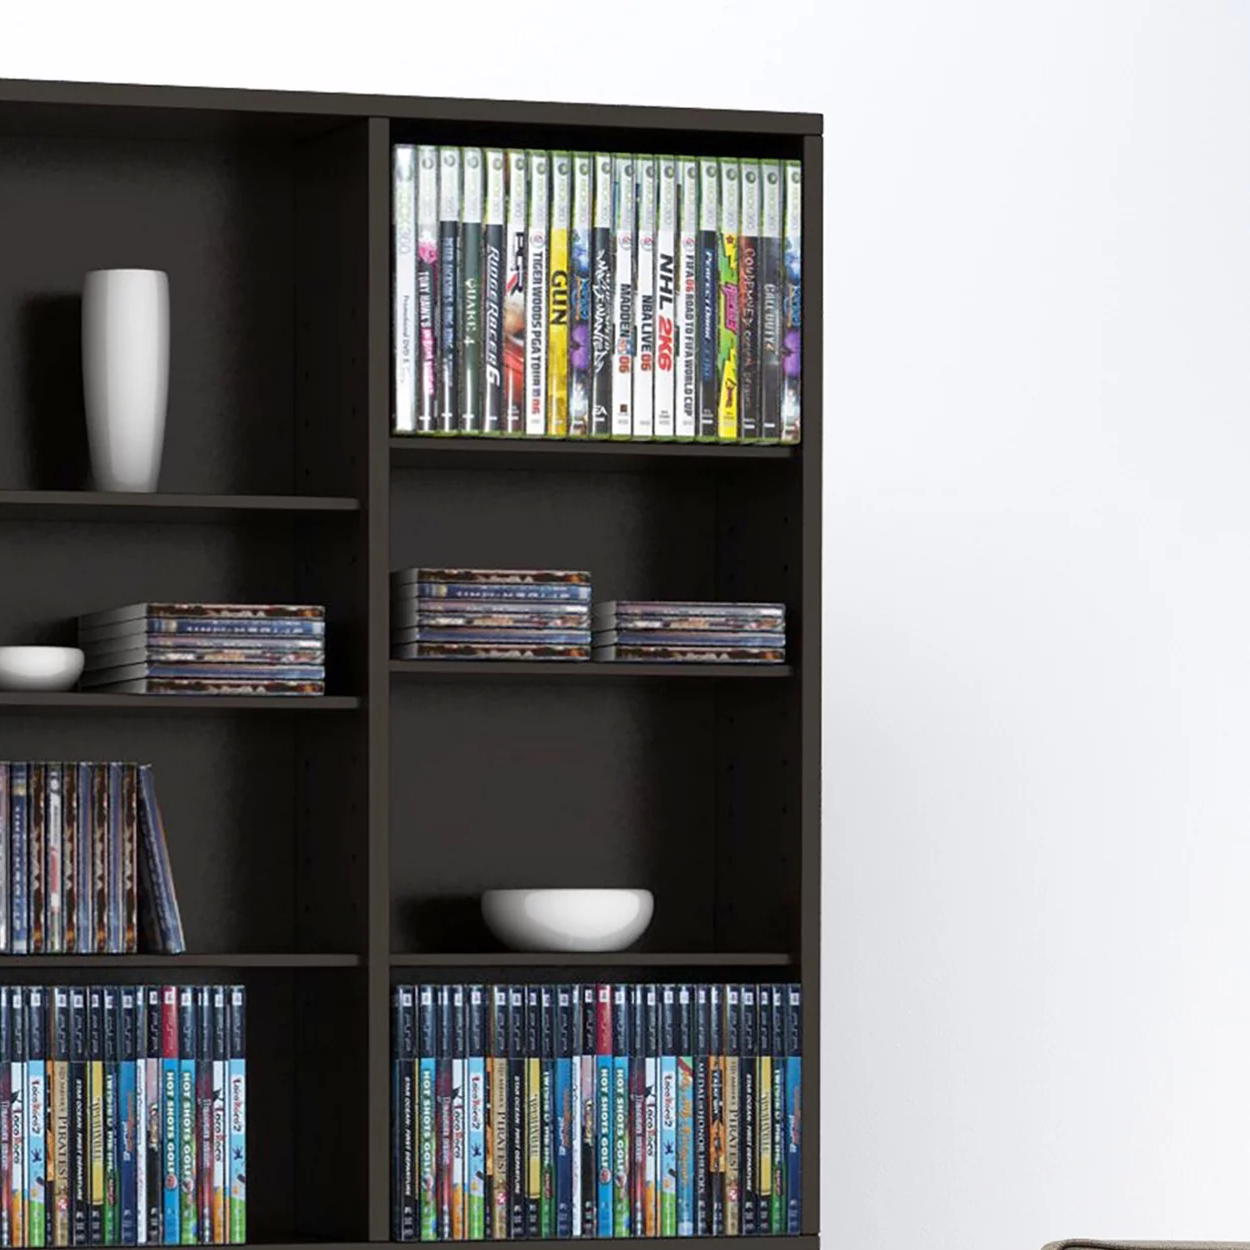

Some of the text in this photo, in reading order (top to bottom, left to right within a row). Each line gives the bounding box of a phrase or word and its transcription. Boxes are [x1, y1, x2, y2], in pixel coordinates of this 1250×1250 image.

[531, 251, 543, 285] TIGER
[531, 286, 543, 328] WOODS
[551, 270, 569, 325] GUN
[619, 283, 631, 374] MADDEN 06
[640, 295, 653, 372] NBA LIVE 06
[657, 253, 674, 372] NHL 2K6
[165, 1072, 175, 1175] HOT SHOTS GOLF
[182, 1072, 191, 1178] HOT SHOTS GOLF
